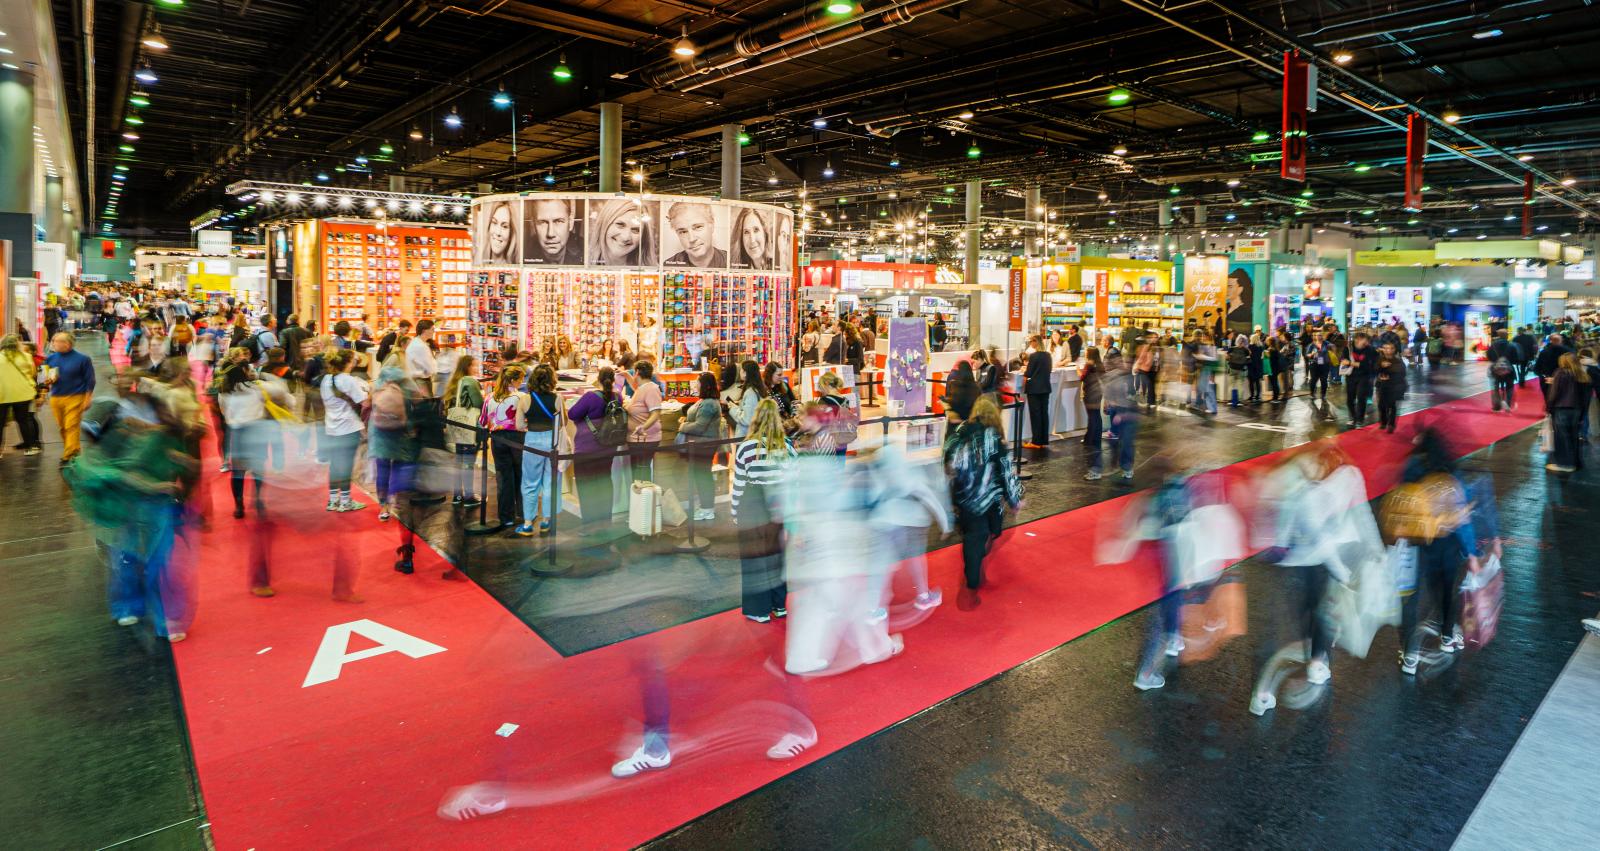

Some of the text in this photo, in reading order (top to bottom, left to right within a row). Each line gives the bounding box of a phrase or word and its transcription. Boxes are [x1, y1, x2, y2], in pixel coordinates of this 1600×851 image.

[1012, 271, 1021, 318] Information
[1099, 275, 1107, 297] Kasse
[301, 618, 449, 689] A
